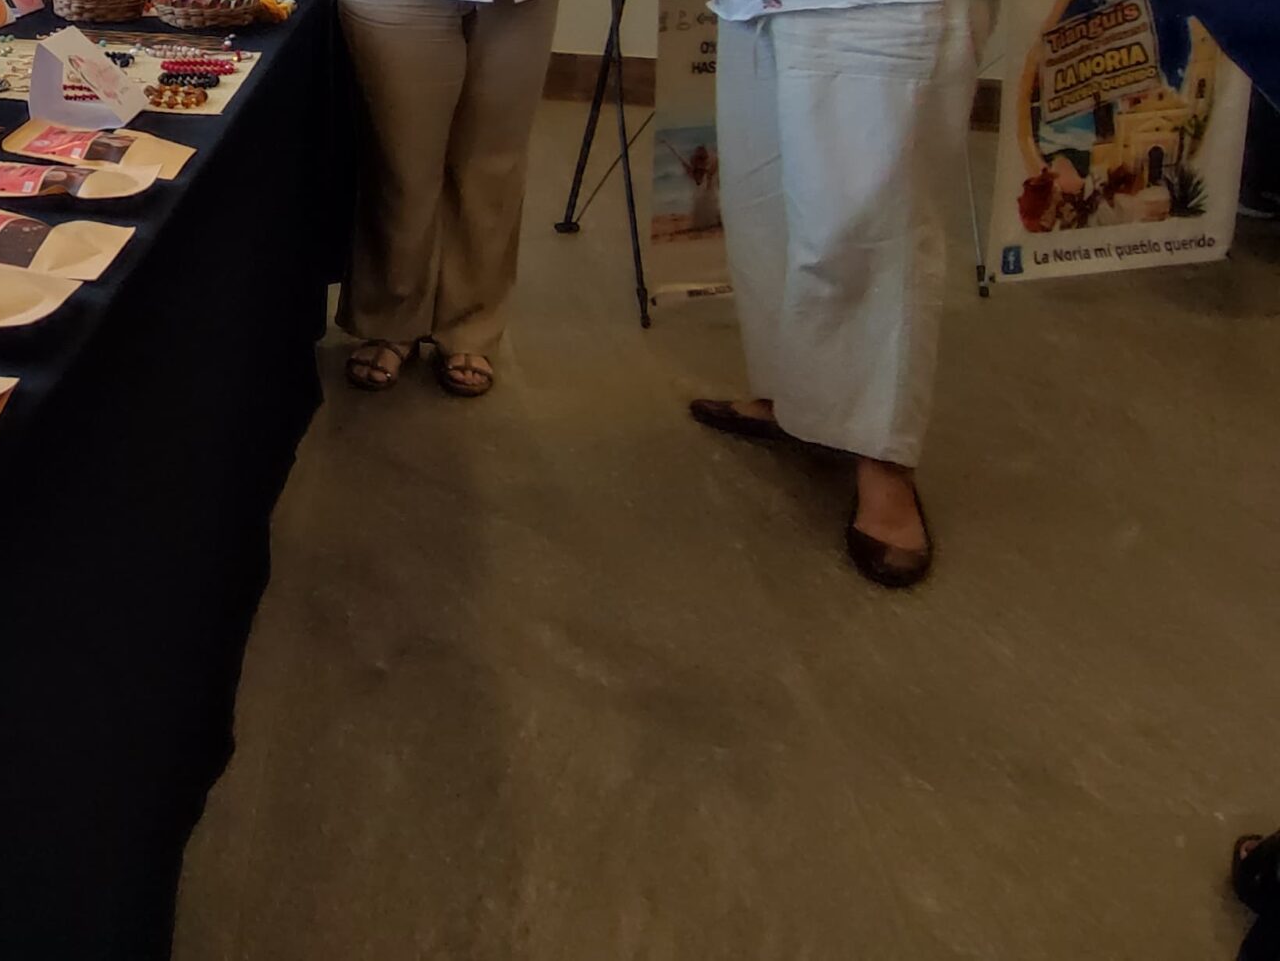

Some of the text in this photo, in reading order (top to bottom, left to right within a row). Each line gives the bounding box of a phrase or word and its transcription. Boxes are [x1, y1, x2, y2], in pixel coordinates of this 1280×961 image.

[1053, 64, 1078, 94] LA
[1077, 42, 1149, 83] NORIA
[1033, 250, 1050, 265] La
[1053, 246, 1091, 262] Noria
[1115, 239, 1161, 260] pueblo
[1164, 234, 1216, 256] querido
